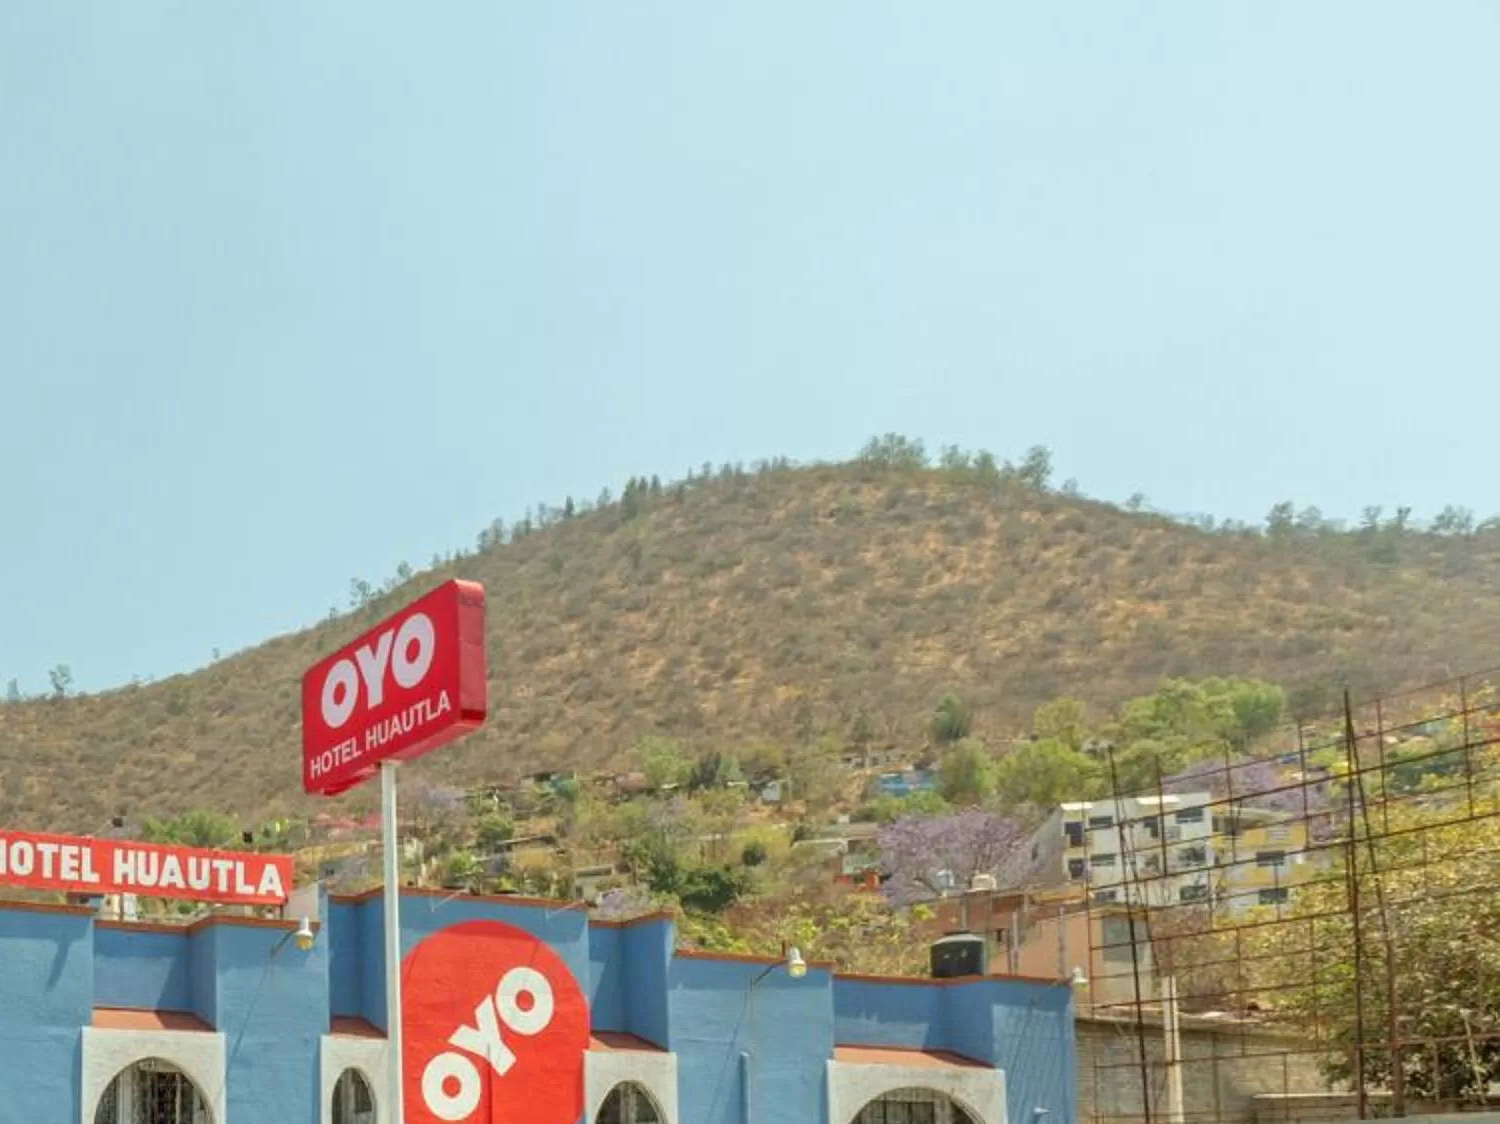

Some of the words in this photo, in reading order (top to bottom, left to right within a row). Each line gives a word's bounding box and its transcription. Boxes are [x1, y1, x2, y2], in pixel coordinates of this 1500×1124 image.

[320, 612, 436, 729] OYO
[310, 737, 362, 779] HOTEL
[365, 690, 451, 750] HUAUTLA
[112, 847, 285, 899] HUAUTLA
[421, 966, 554, 1121] OYO
